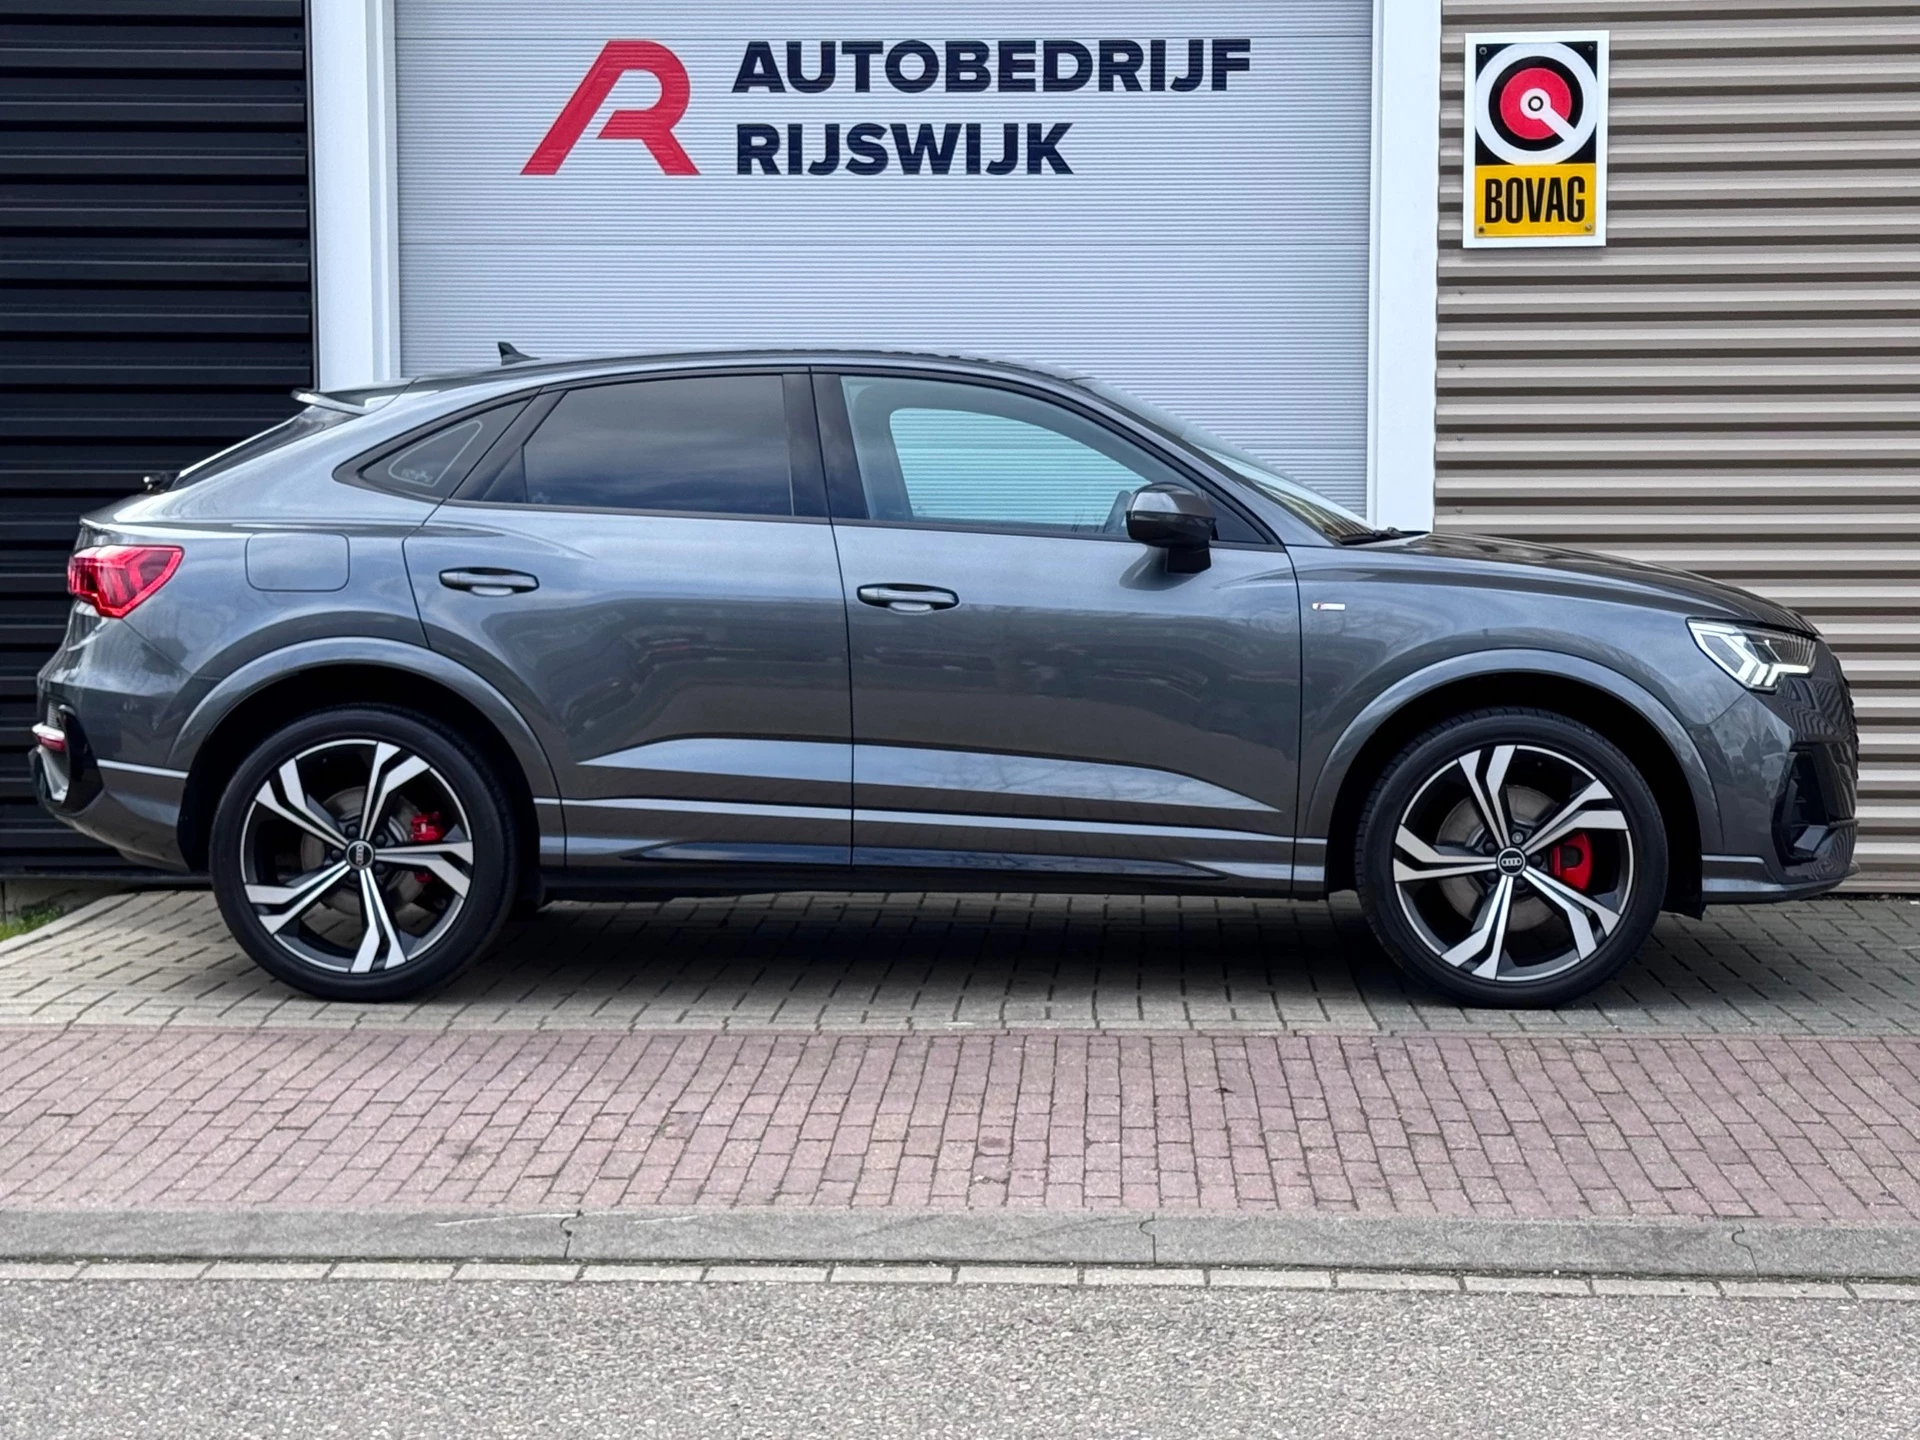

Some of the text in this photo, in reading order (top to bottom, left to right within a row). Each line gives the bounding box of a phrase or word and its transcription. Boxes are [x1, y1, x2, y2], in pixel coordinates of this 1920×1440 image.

[732, 38, 1251, 93] AUTOBEDRIJF
[737, 123, 1074, 175] RIJSWIJK
[1484, 176, 1585, 224] BOVAG
